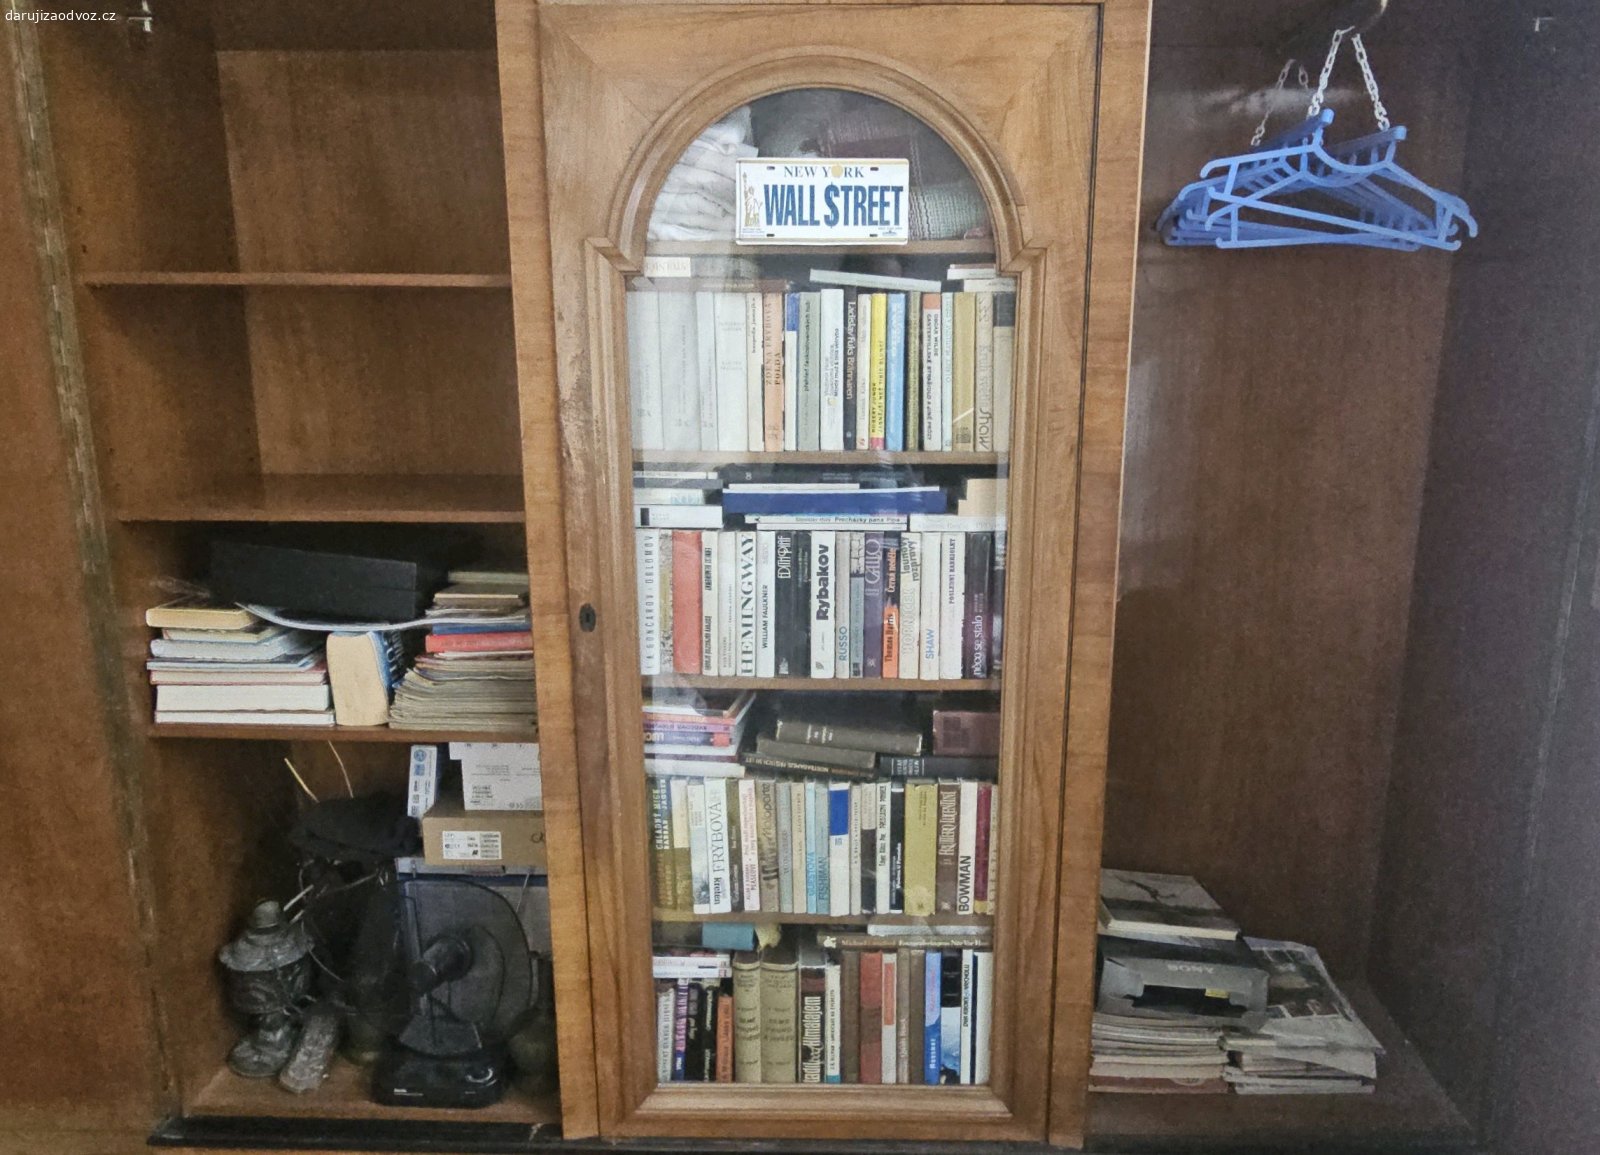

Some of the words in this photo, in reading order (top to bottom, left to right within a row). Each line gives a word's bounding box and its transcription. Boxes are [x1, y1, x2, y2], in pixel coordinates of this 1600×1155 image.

[784, 166, 817, 178] NEW
[764, 184, 820, 226] WALL
[848, 302, 856, 336] Ladislav
[978, 408, 991, 451] Shaw
[644, 536, 654, 584] OBLOMOV
[761, 584, 769, 618] FAULKNER
[816, 544, 830, 621] Rybakov
[644, 595, 654, 649] GONČAROV
[740, 534, 754, 674] HEMINGWAY
[761, 620, 769, 649] WILLIAM
[838, 626, 848, 661] RUSSO
[924, 628, 935, 660] SHAW
[970, 614, 983, 638] stalo
[970, 652, 983, 677] něco
[974, 640, 984, 651] se
[708, 802, 725, 872] FRYBOVÁ
[818, 856, 828, 900] FISHMAN
[958, 855, 972, 912] BOWMAN
